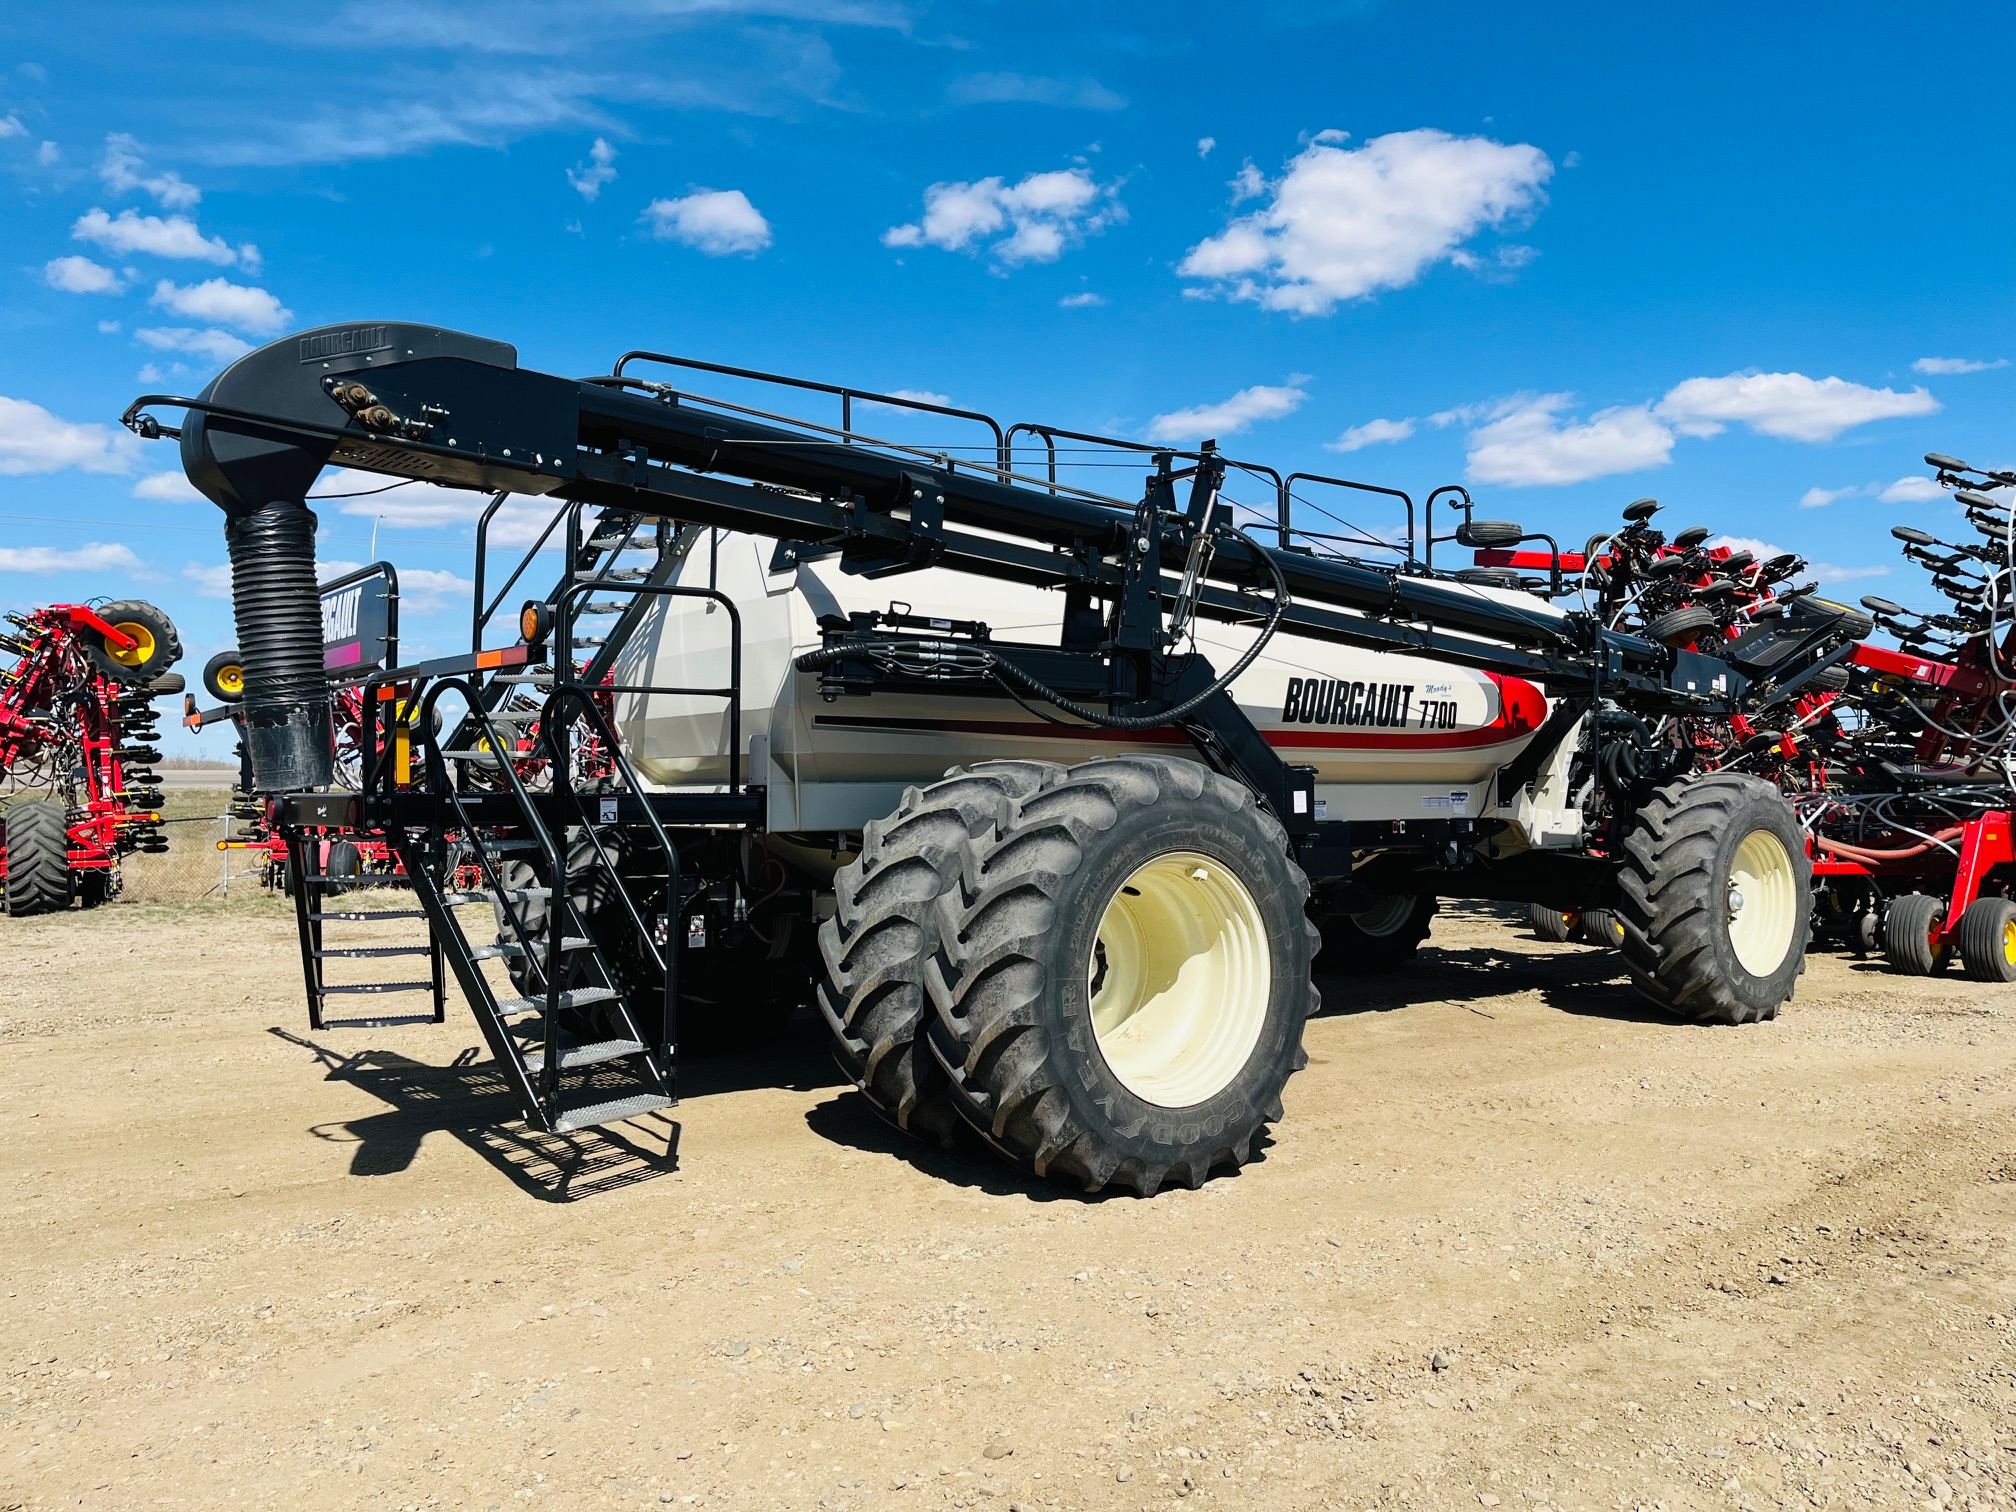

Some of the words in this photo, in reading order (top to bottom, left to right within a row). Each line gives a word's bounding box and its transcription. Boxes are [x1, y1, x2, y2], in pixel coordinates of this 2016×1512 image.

[300, 326, 386, 360] BOURGAULT
[320, 587, 363, 644] RGAULT
[1282, 677, 1415, 728] BOURGAULT
[1419, 700, 1458, 729] 7700
[1425, 682, 1452, 694] Moody's
[1062, 984, 1246, 1146] GOODYEAR
